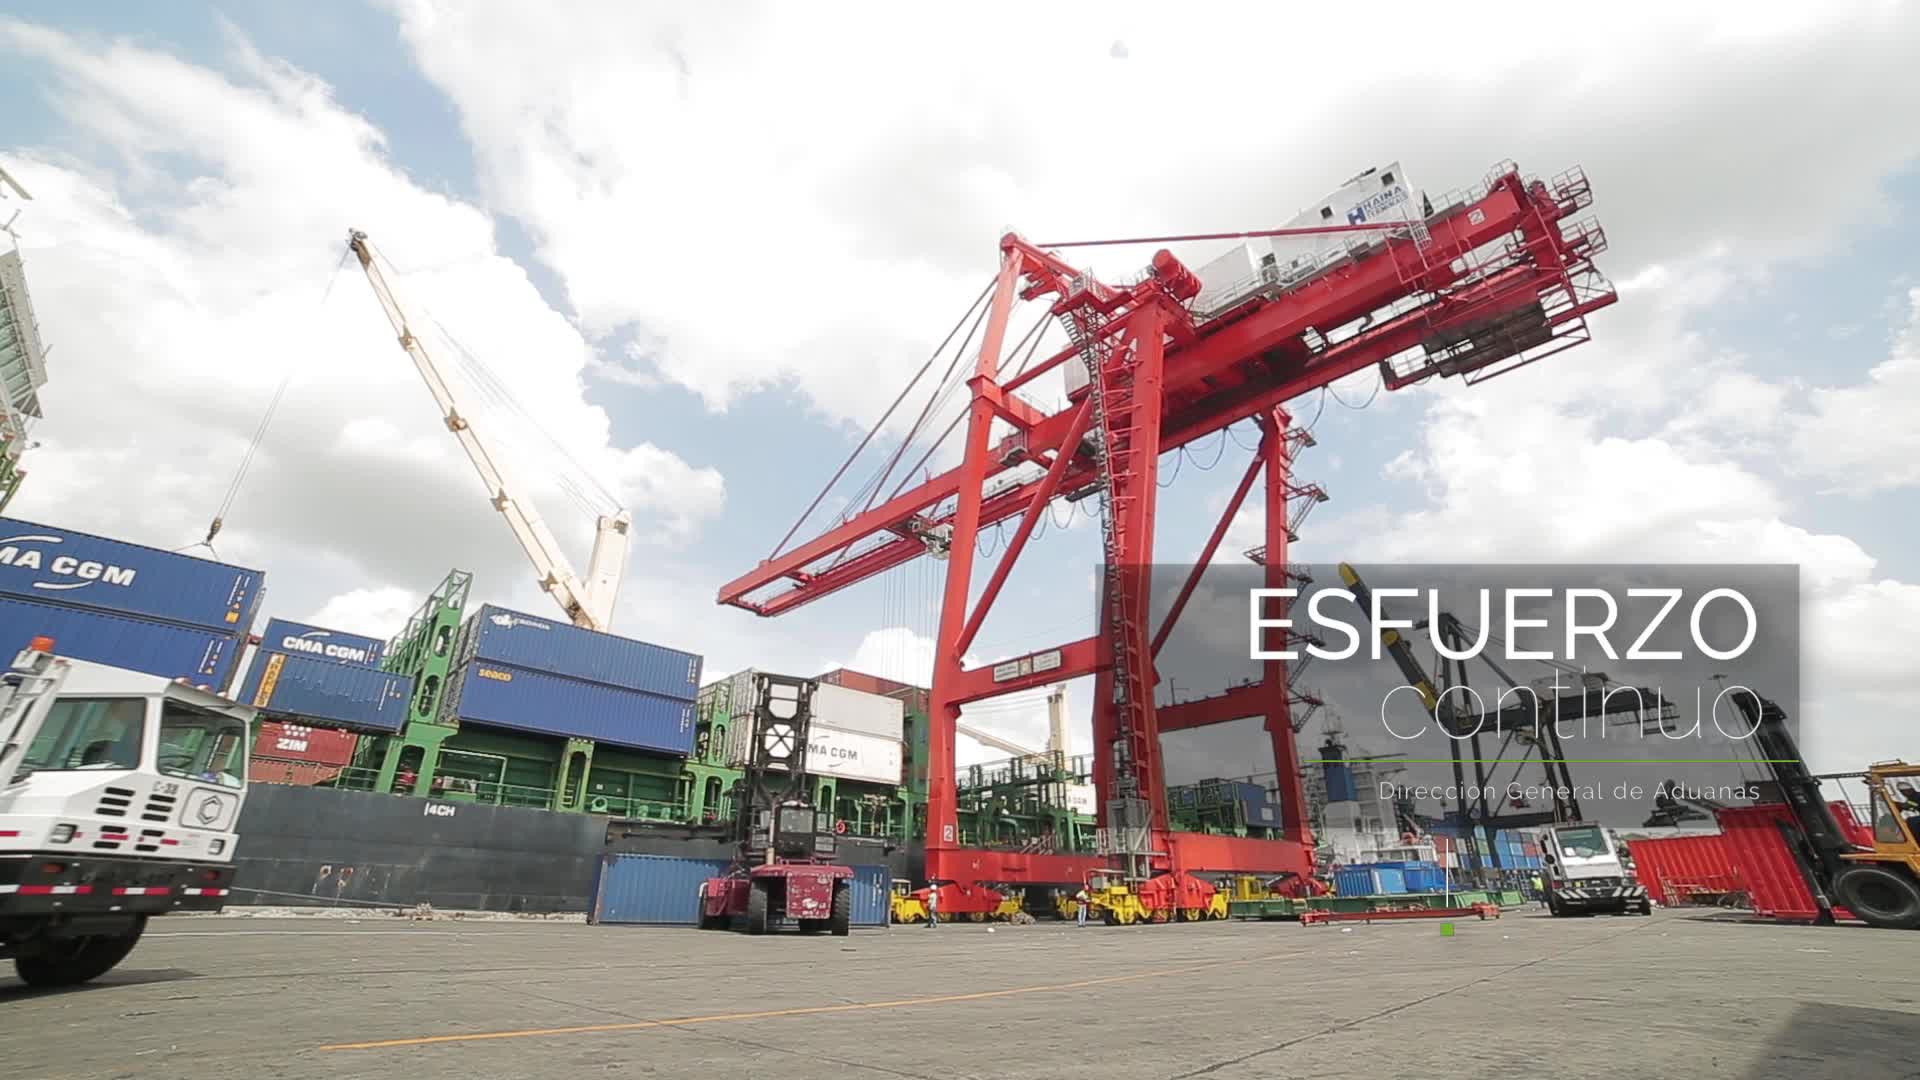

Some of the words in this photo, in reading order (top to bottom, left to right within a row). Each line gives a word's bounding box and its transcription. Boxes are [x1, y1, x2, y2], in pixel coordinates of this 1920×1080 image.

[1363, 186, 1403, 211] HAINA
[51, 556, 136, 586] CGM
[282, 635, 323, 655] CMA
[325, 643, 366, 663] CGM
[478, 668, 512, 682] seaco
[276, 737, 309, 752] ZIM
[831, 747, 858, 761] CGM
